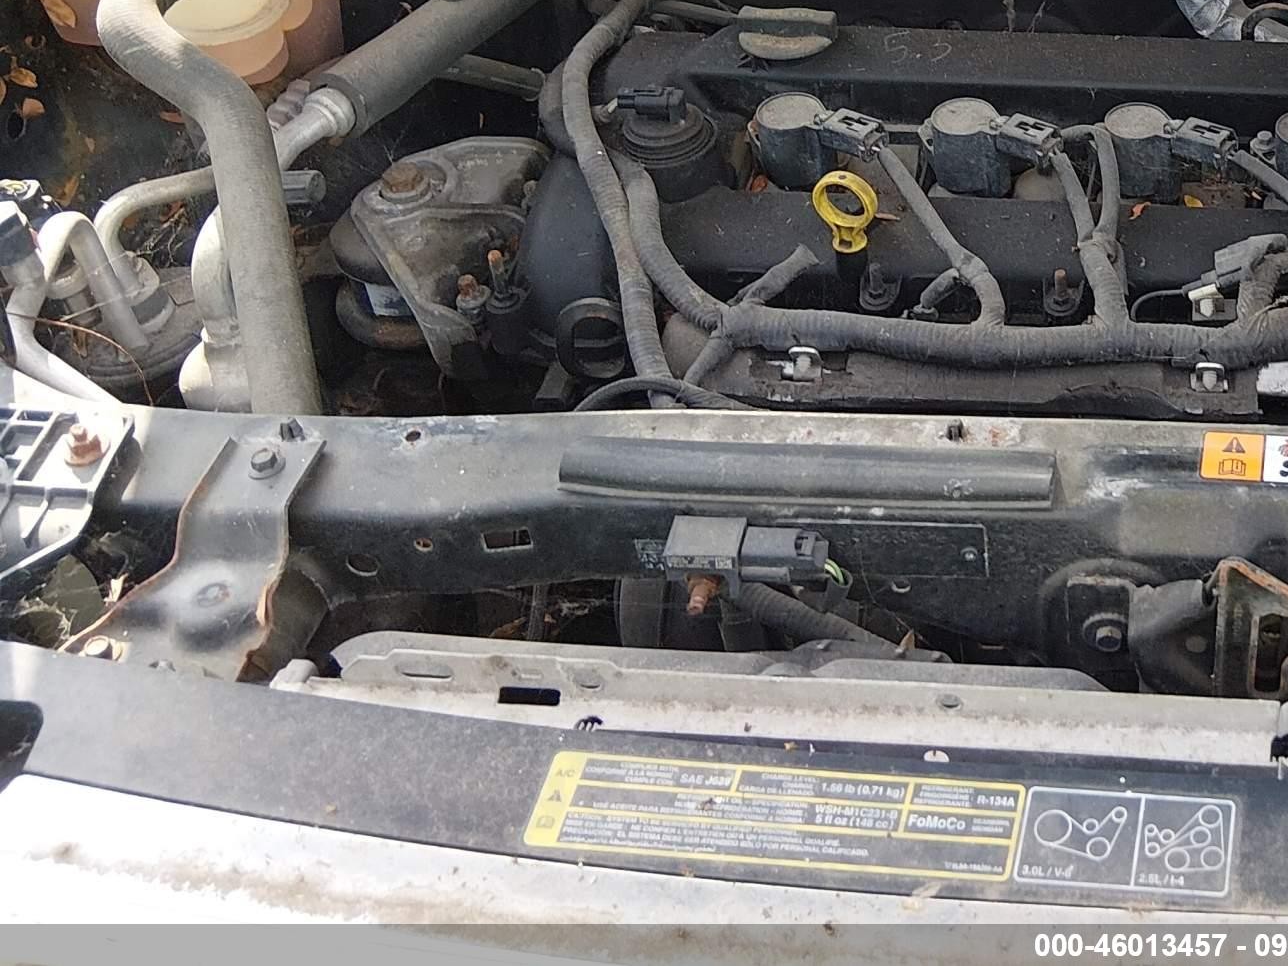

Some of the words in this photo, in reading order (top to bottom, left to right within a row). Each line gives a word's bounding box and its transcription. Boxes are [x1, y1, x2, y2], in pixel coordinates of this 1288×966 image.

[679, 773, 704, 784] SAE
[856, 784, 884, 797] (0.71
[886, 786, 905, 800] kg)
[976, 794, 1016, 808] R-134A
[907, 813, 967, 831] FoMoCo
